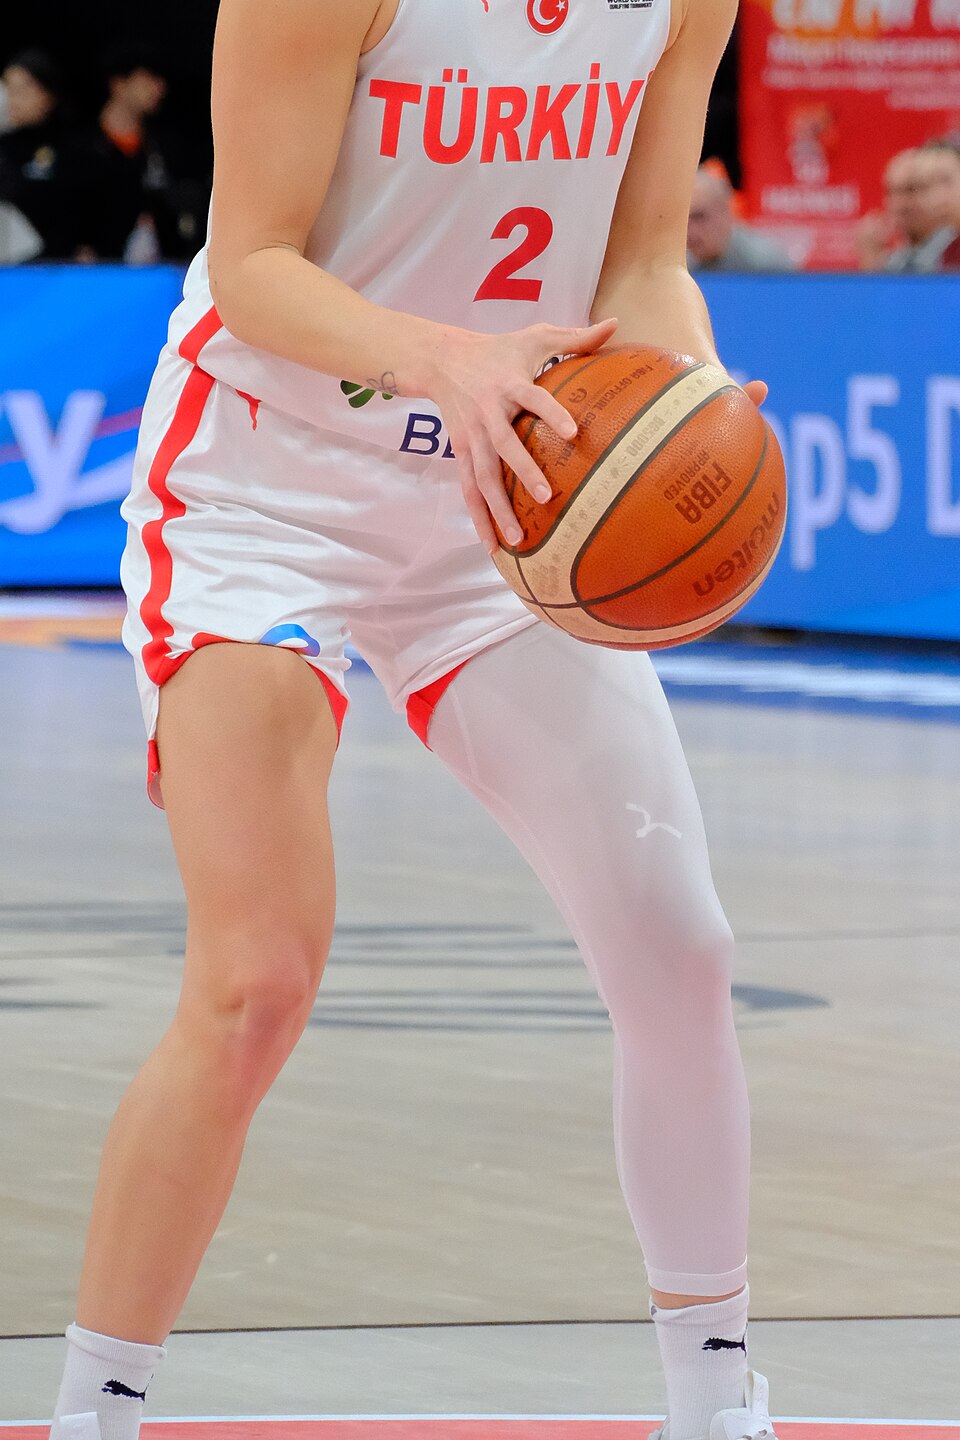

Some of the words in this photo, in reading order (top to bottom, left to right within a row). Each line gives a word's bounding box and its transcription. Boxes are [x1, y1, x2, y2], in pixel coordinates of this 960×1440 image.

[369, 62, 655, 164] TÜRKİY
[472, 206, 554, 302] 2
[596, 377, 633, 411] OFFICIAL
[631, 364, 653, 380] FIBA
[663, 449, 710, 501] APPROVED
[674, 461, 732, 525] FIBA
[764, 372, 901, 571] p5
[692, 491, 780, 597] molten
